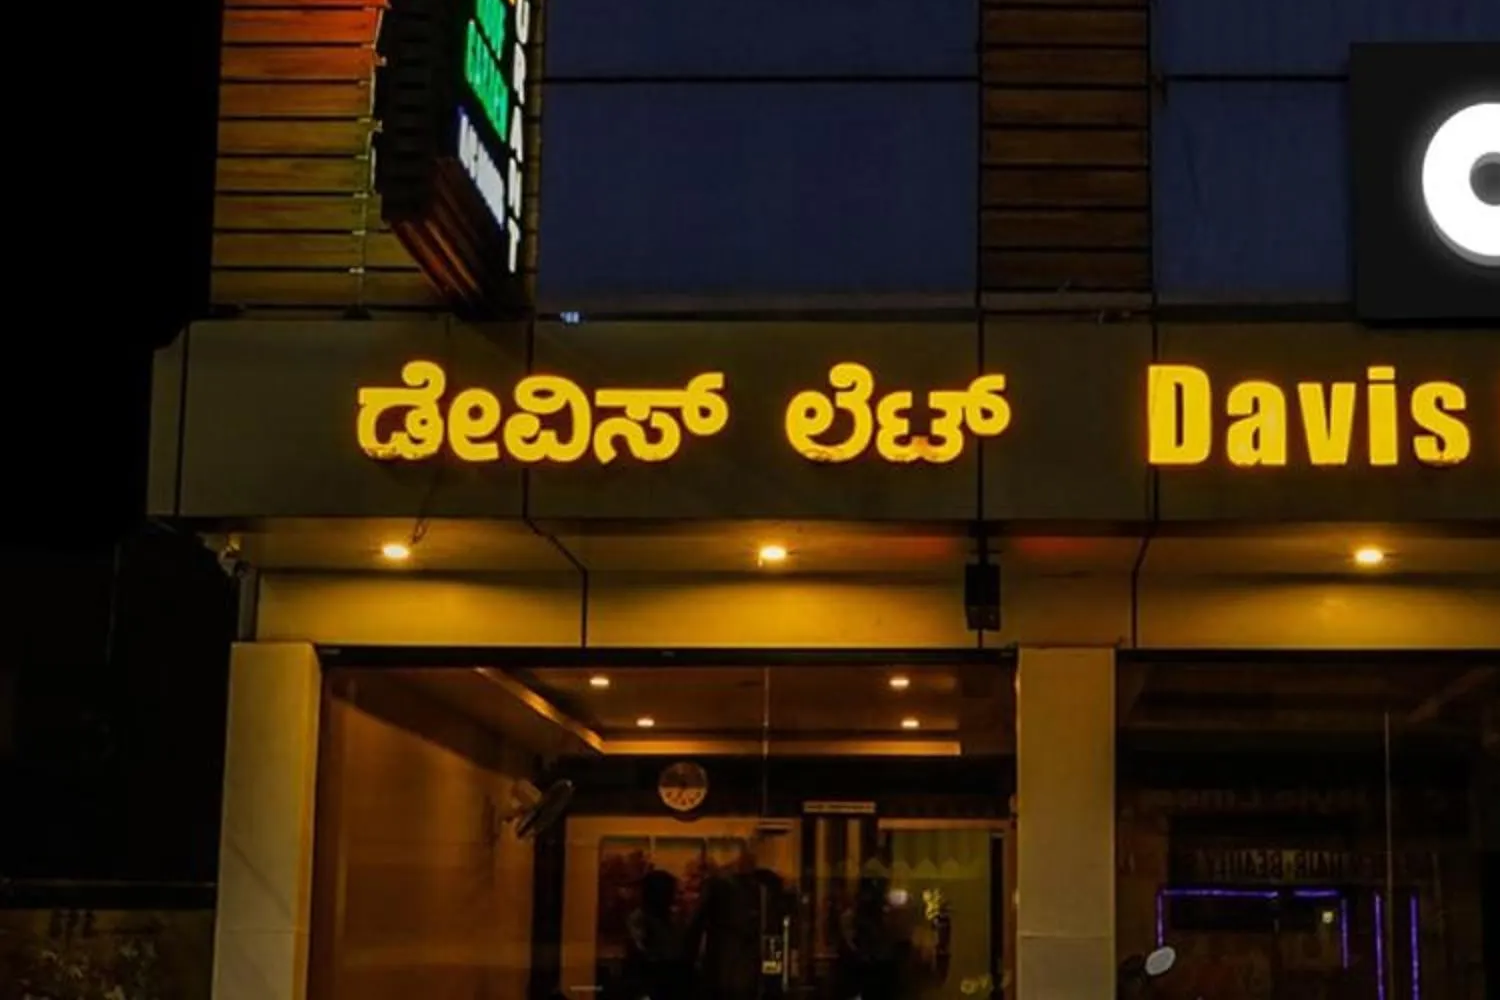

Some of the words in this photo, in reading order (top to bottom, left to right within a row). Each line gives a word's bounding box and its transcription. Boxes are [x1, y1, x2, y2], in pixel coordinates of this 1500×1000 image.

[356, 360, 729, 464] ಡೇವಿಸ್
[784, 361, 1011, 462] ಲೆಟ್
[1146, 364, 1471, 466] Davis
